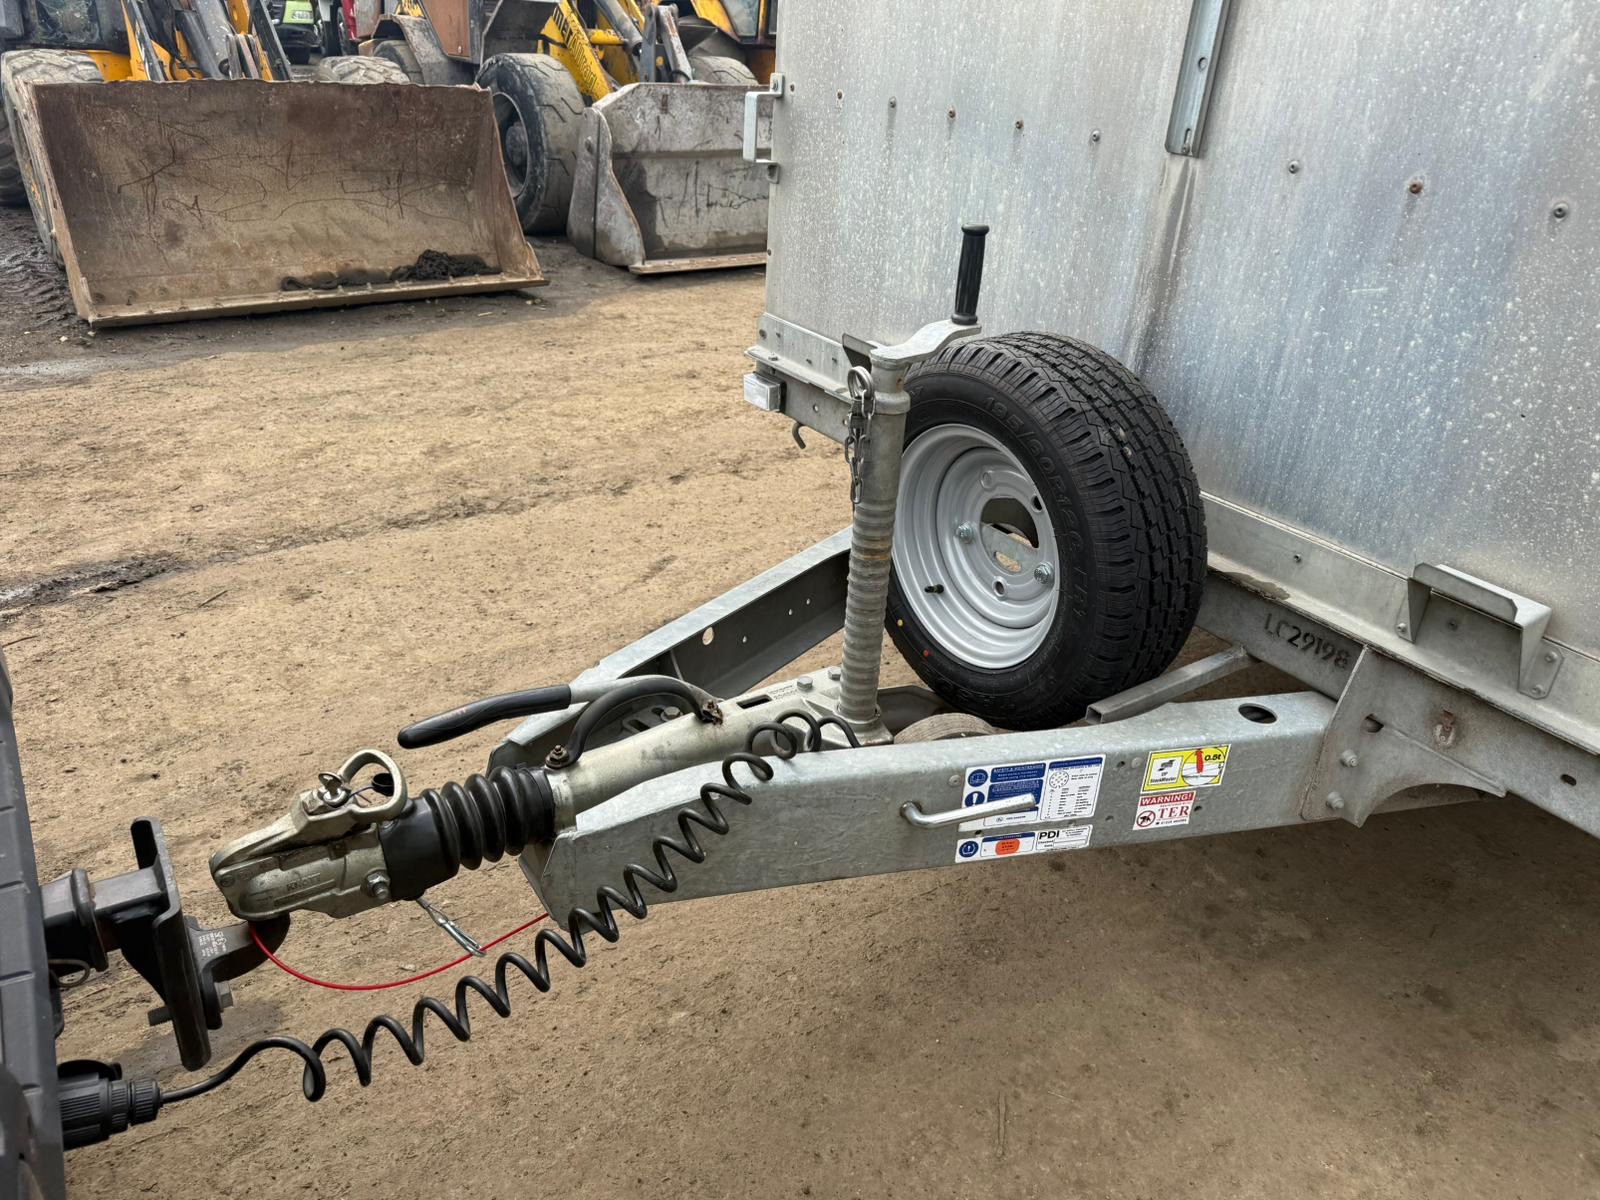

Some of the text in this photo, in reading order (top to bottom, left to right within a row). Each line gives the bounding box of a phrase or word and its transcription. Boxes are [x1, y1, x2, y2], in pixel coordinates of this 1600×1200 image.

[1204, 753, 1222, 762] 0.5t
[1142, 793, 1192, 805] WARNING!
[1158, 805, 1190, 819] TER
[1039, 830, 1060, 840] PDI
